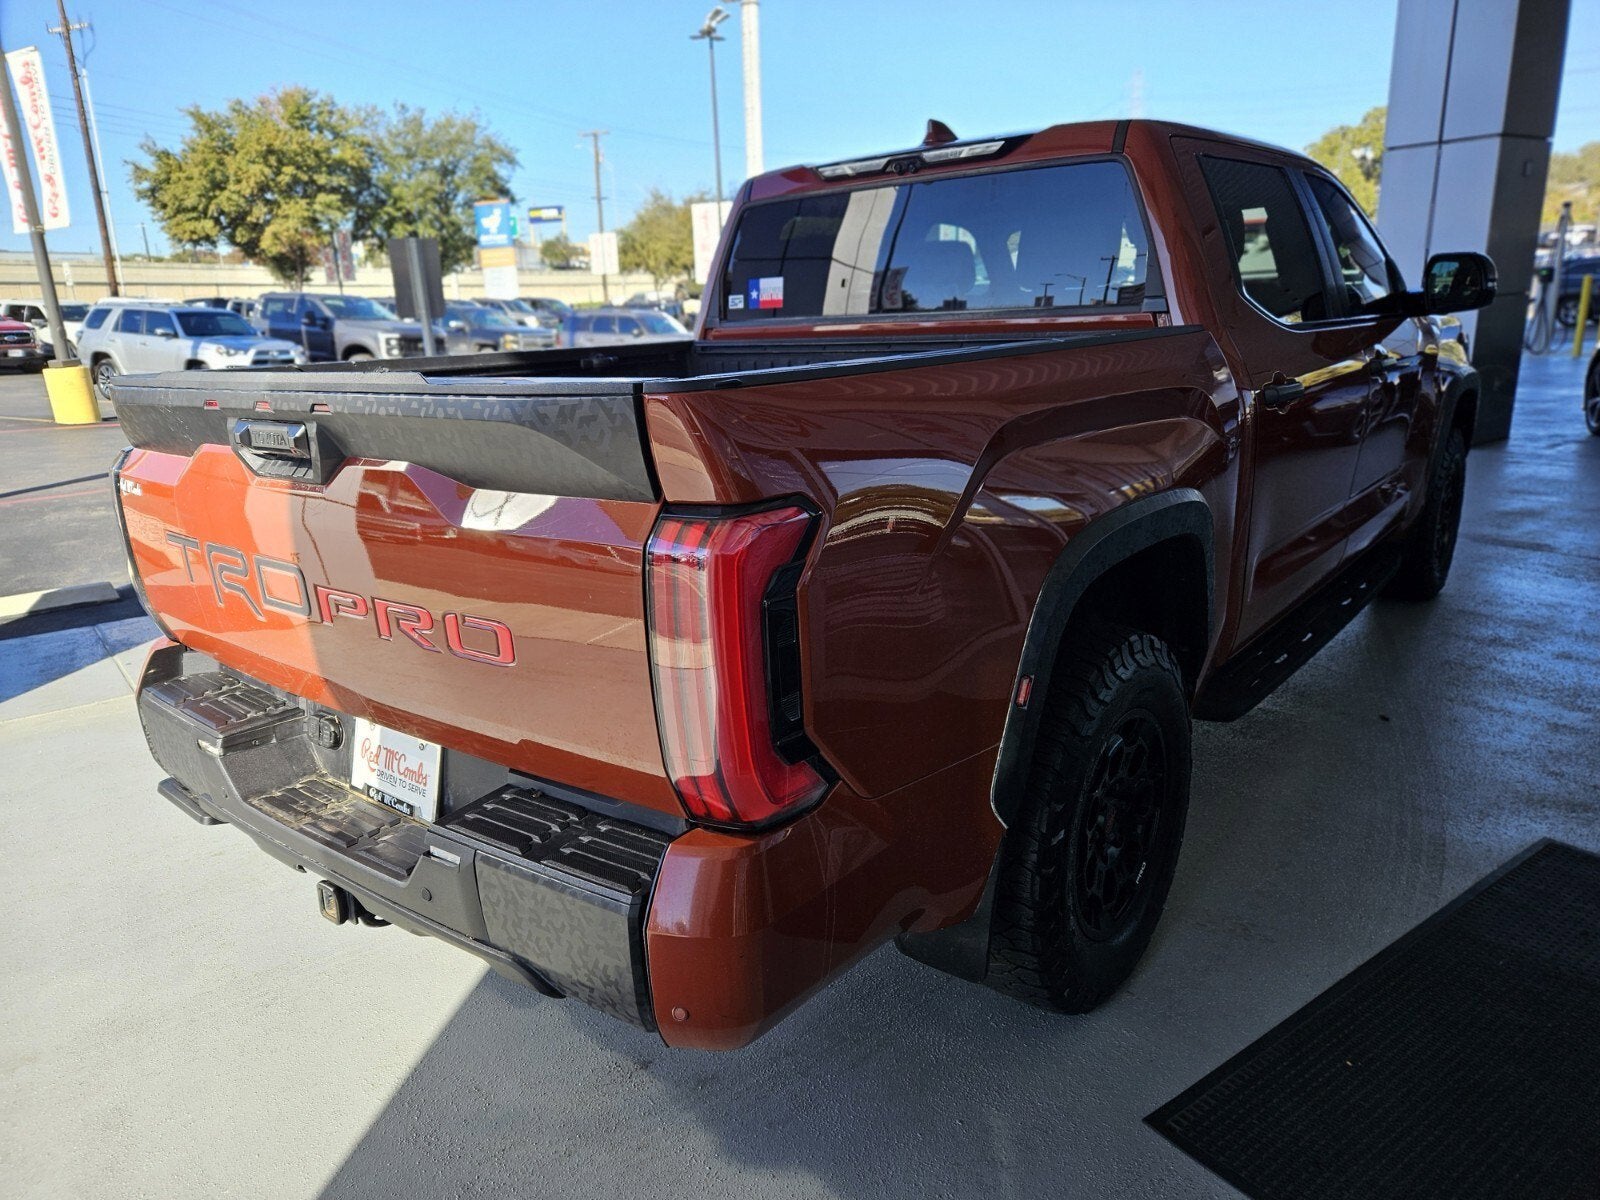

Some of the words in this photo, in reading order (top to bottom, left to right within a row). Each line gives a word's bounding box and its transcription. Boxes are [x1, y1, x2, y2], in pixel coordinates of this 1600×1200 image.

[251, 430, 288, 447] TOYOTA
[166, 530, 312, 621] TRD
[313, 584, 517, 666] PRO
[362, 737, 381, 773] Red
[383, 746, 428, 787] McCombs
[369, 787, 382, 801] Red
[376, 769, 398, 785] DRIVEN
[398, 778, 407, 789] TO
[407, 783, 428, 798] SERVE
